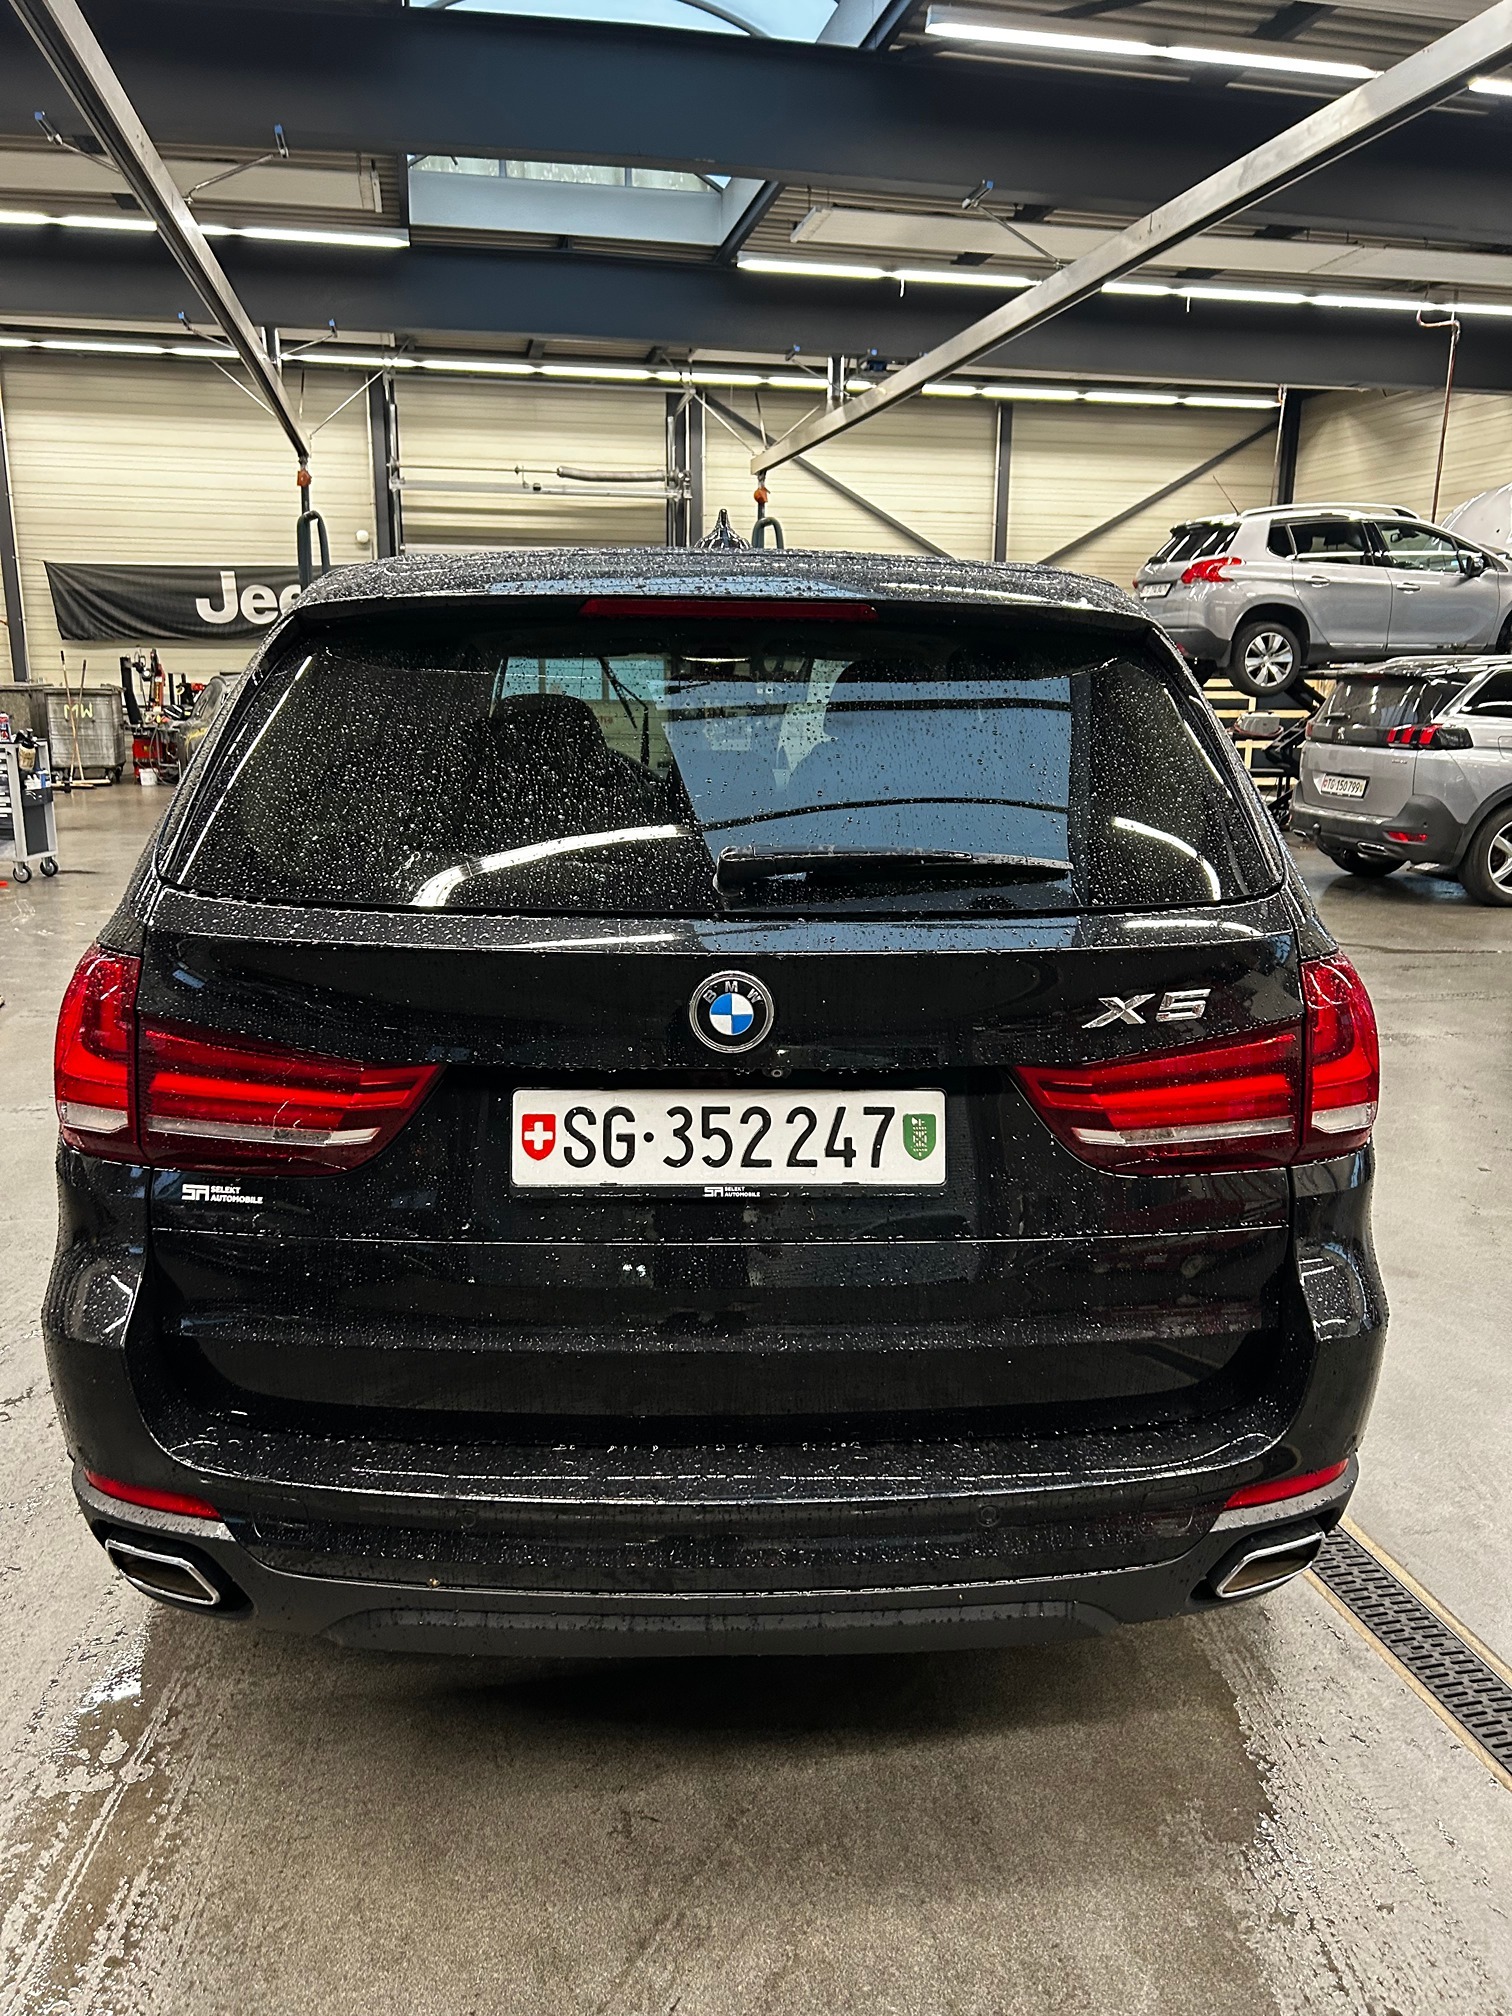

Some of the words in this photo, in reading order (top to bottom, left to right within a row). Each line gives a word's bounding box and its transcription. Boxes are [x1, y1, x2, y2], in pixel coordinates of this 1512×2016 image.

[63, 702, 93, 719] MW
[702, 980, 764, 1004] BMW
[1081, 988, 1212, 1028] X5
[210, 1185, 241, 1194] SELEKT
[210, 1194, 264, 1204] AUTOMOBILE
